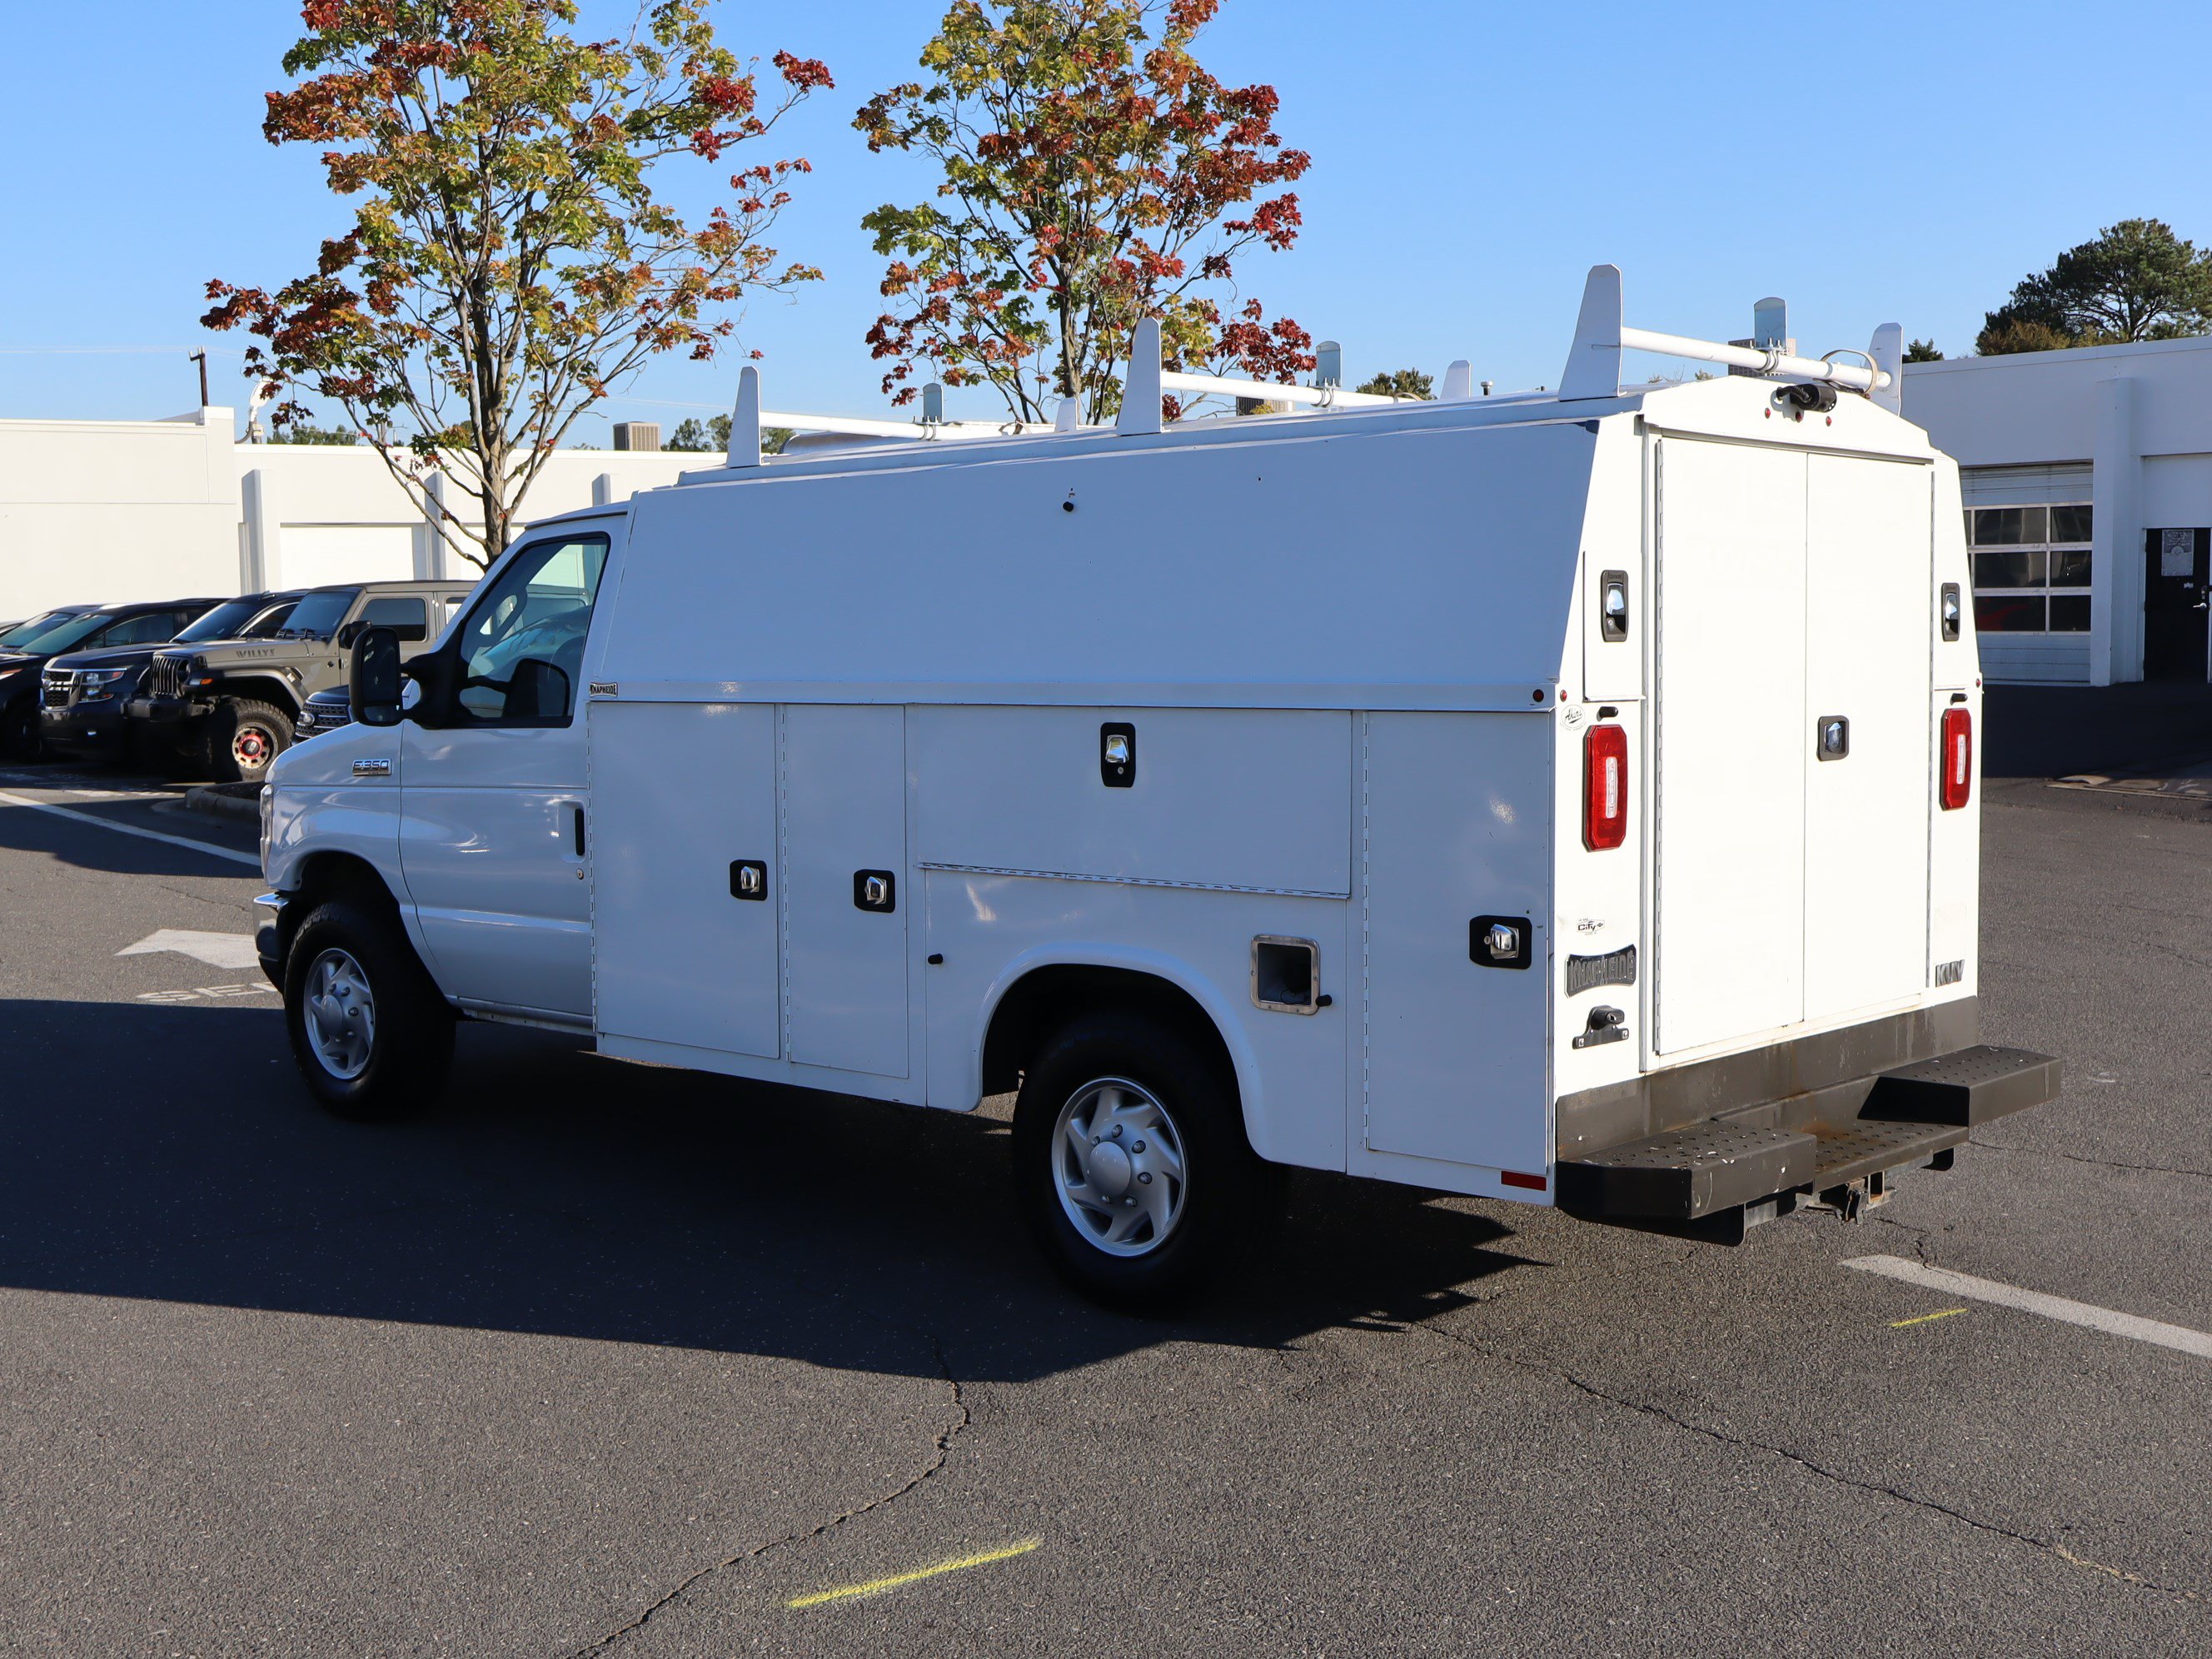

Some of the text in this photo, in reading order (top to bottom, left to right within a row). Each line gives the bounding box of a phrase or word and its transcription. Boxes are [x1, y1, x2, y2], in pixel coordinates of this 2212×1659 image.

[236, 648, 276, 658] WILLYS
[590, 684, 616, 695] KNAPHEIDE
[1570, 949, 1635, 991] KNAPHEIDE
[1936, 959, 1965, 988] KUV
